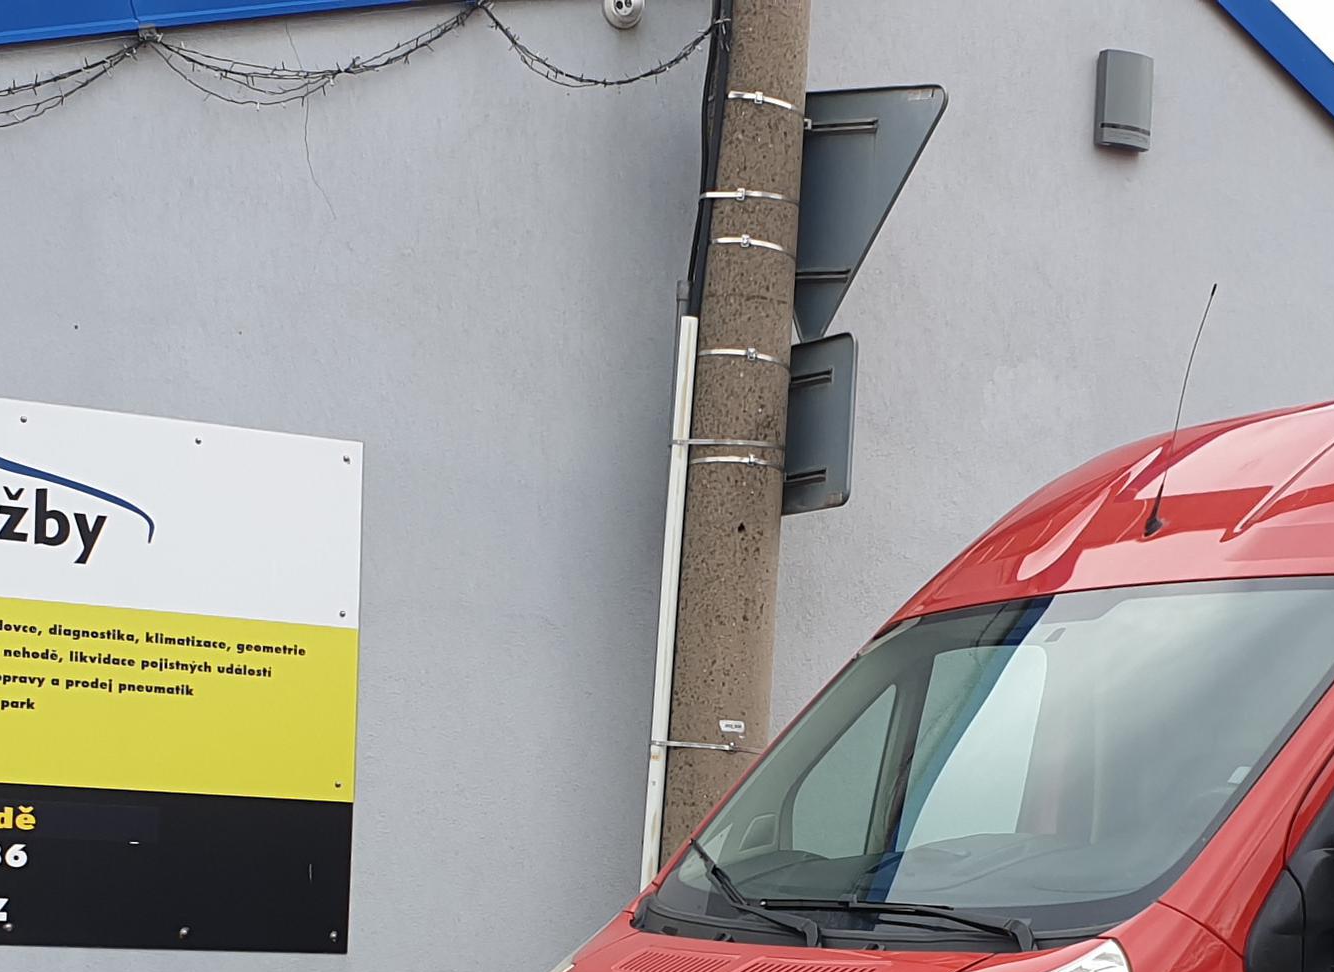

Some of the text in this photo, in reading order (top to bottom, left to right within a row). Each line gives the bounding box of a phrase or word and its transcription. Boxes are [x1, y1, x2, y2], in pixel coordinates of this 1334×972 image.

[48, 623, 140, 644] diagnostika,
[145, 631, 231, 652] klimatizace,
[236, 643, 306, 656] geometrie
[3, 646, 63, 664] nehodě,
[69, 650, 136, 667] likvidace
[140, 657, 212, 675] pojistných
[50, 678, 60, 686] a
[65, 677, 113, 693] prodej
[118, 683, 194, 696] pneumatik
[0, 697, 35, 711] park
